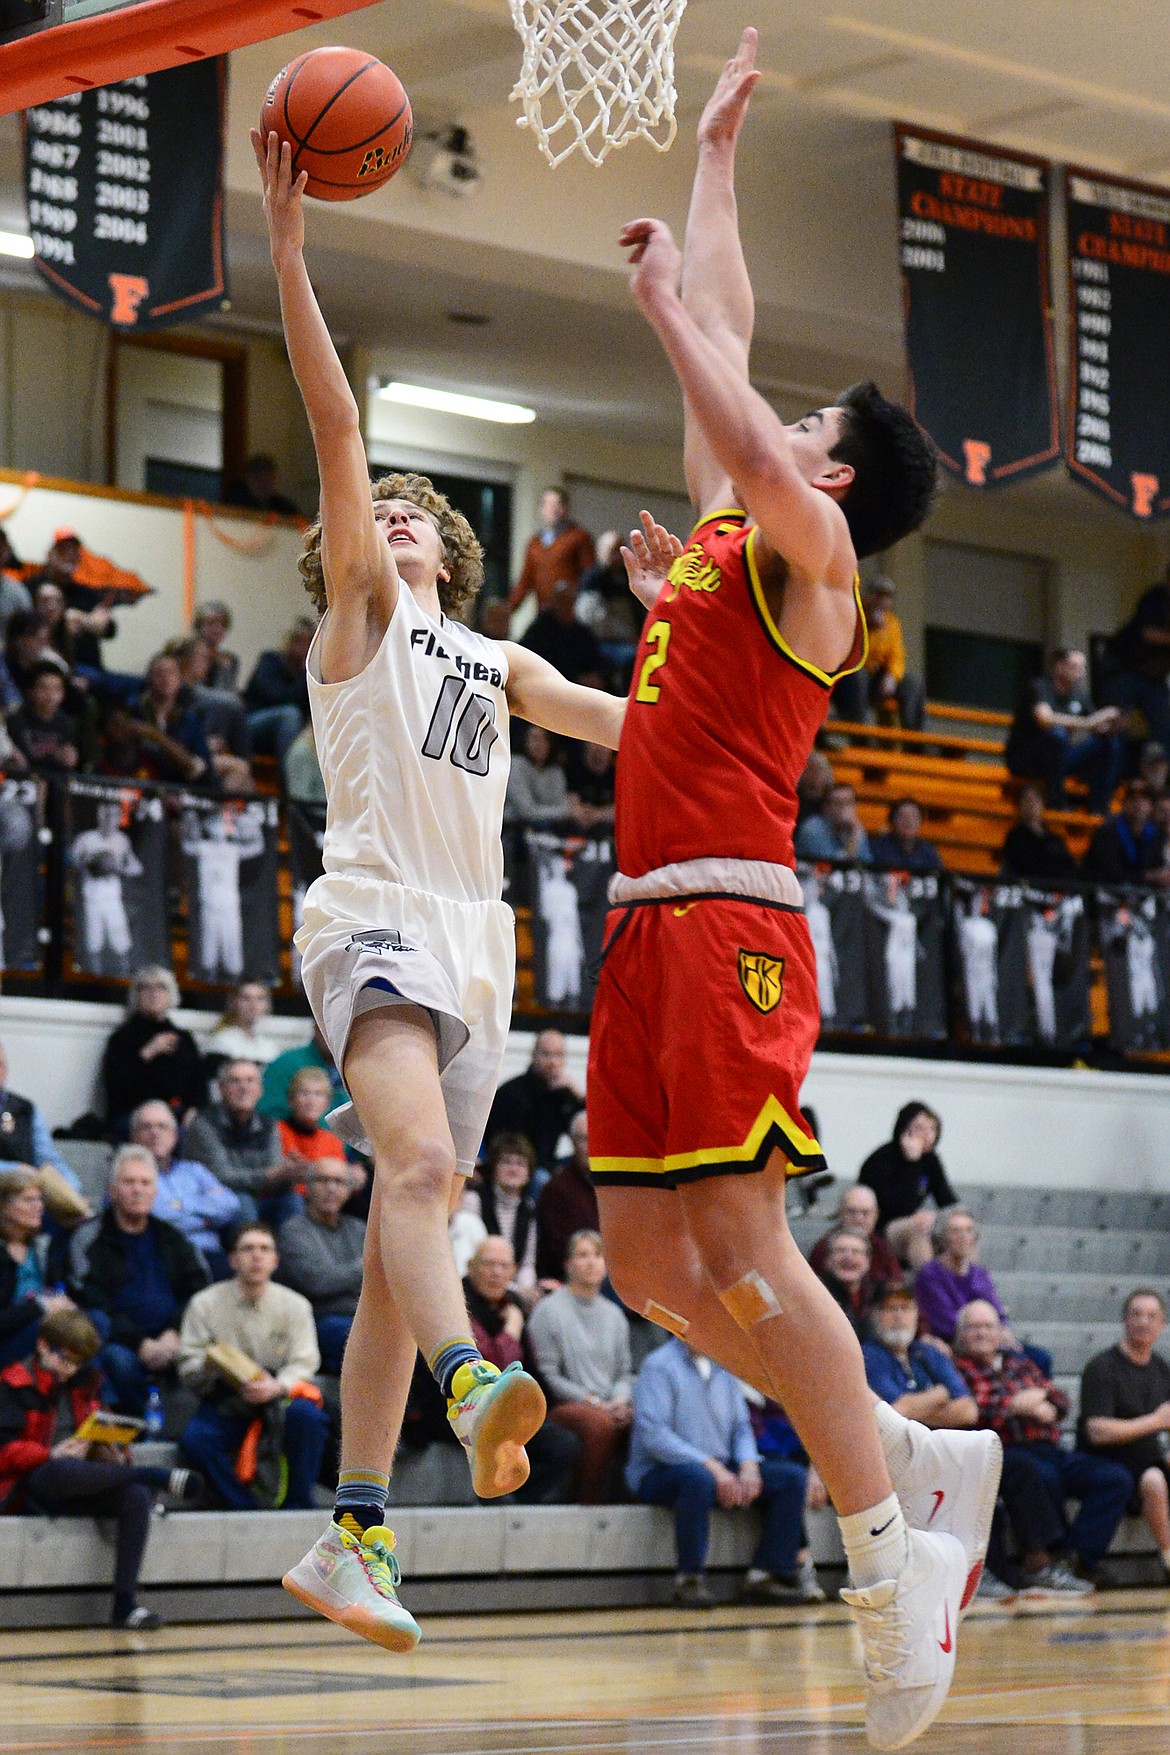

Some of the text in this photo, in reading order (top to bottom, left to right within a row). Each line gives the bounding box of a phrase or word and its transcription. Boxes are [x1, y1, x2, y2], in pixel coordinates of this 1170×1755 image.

[109, 273, 149, 324] F
[636, 619, 671, 704] 2
[421, 674, 499, 777] 10
